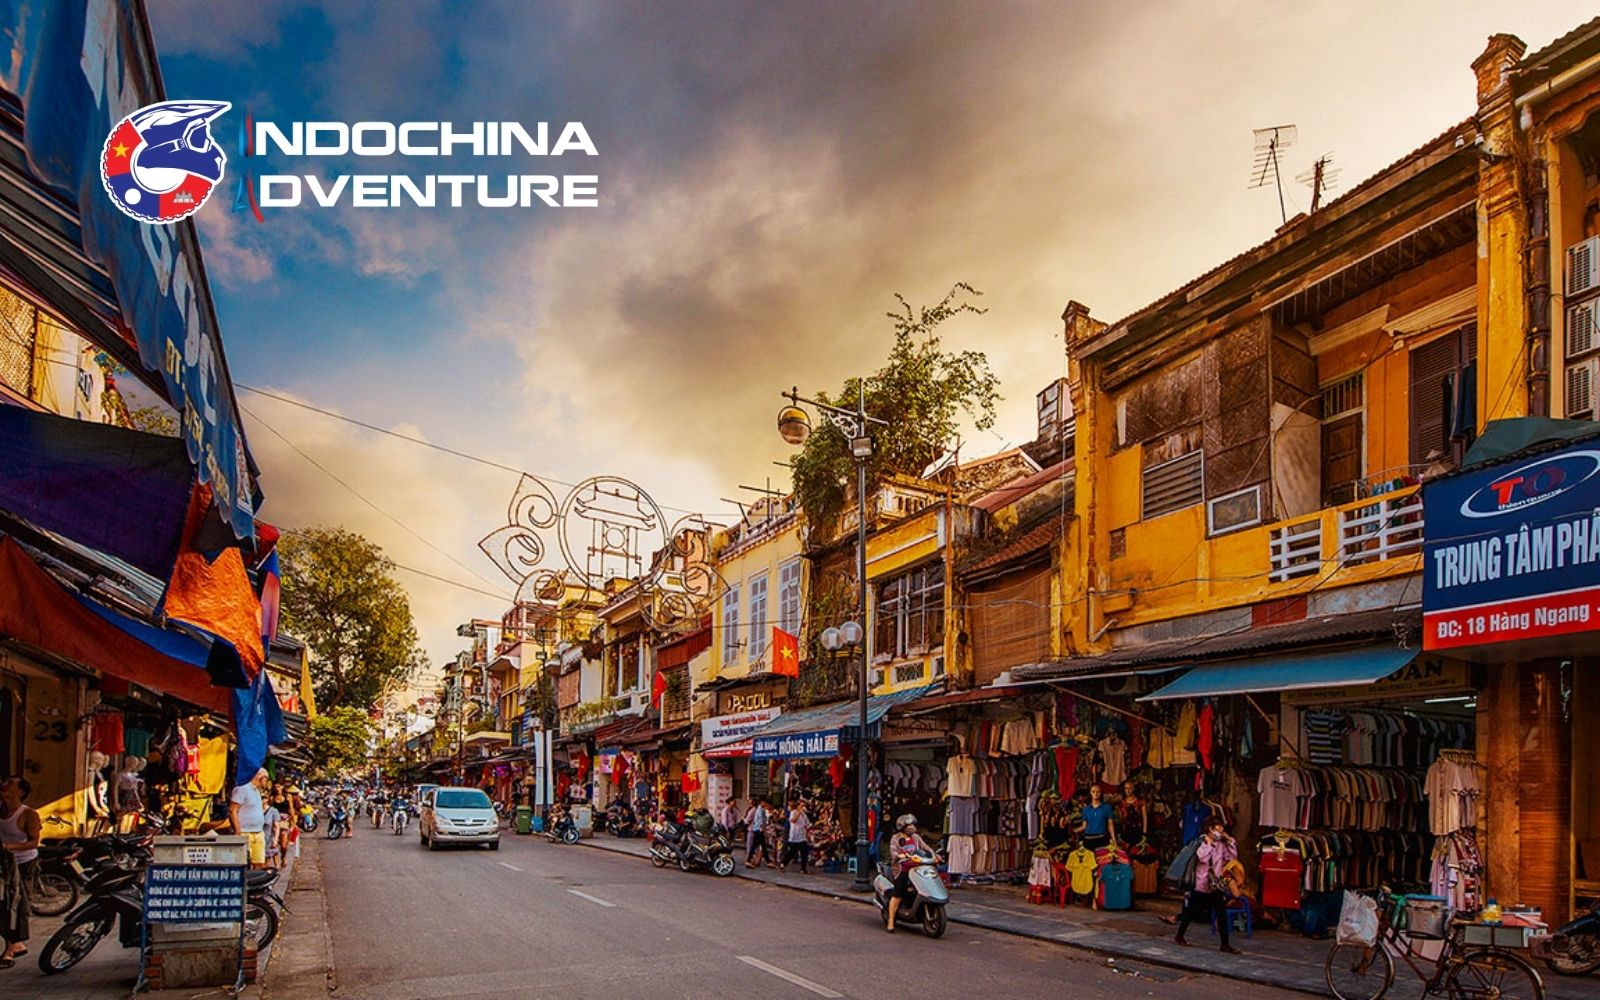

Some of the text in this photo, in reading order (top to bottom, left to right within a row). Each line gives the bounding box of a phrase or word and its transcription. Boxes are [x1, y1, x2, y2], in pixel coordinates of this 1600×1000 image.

[1434, 537, 1501, 589] TRUNG
[1505, 522, 1553, 577] TÂM
[1437, 604, 1590, 639] ĐC: 18 Hàng Ngang
[34, 721, 68, 741] 23
